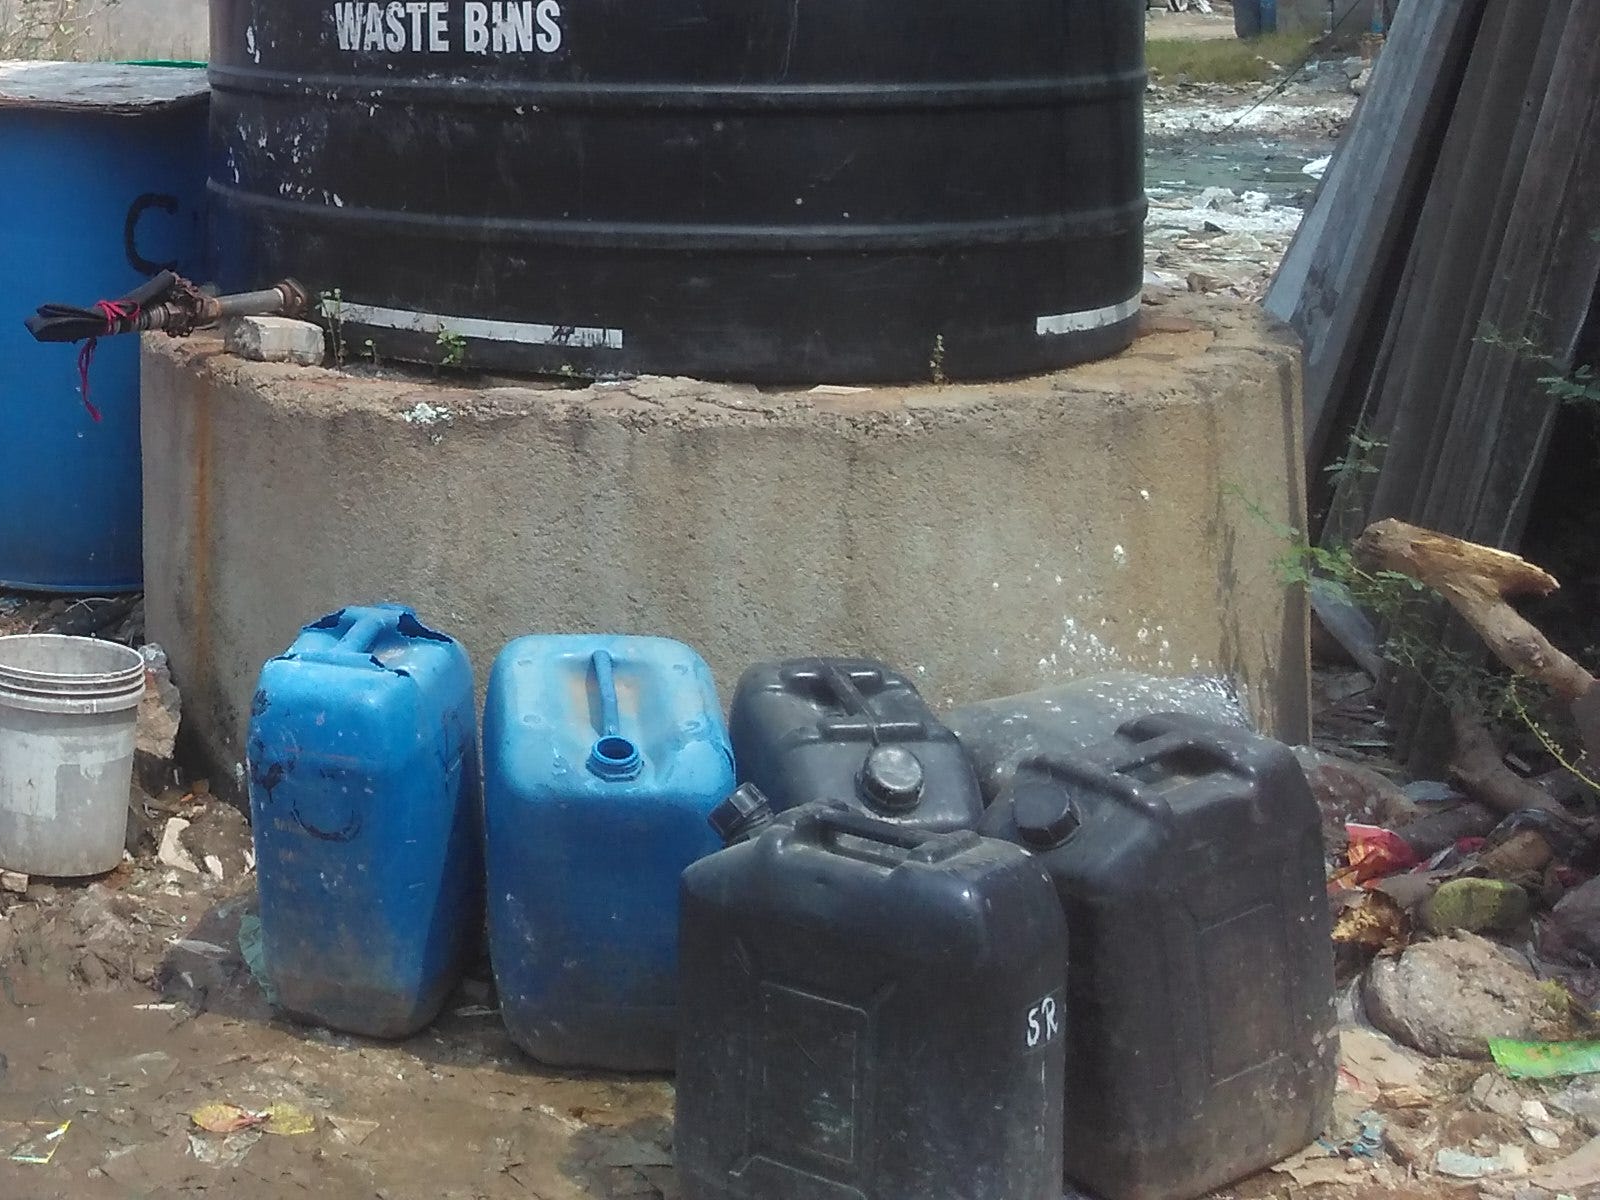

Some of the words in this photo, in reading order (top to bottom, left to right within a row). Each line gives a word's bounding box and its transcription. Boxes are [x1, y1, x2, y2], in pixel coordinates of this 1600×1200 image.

[334, 0, 450, 52] WASTE
[465, 0, 562, 54] BINS
[124, 192, 180, 278] C
